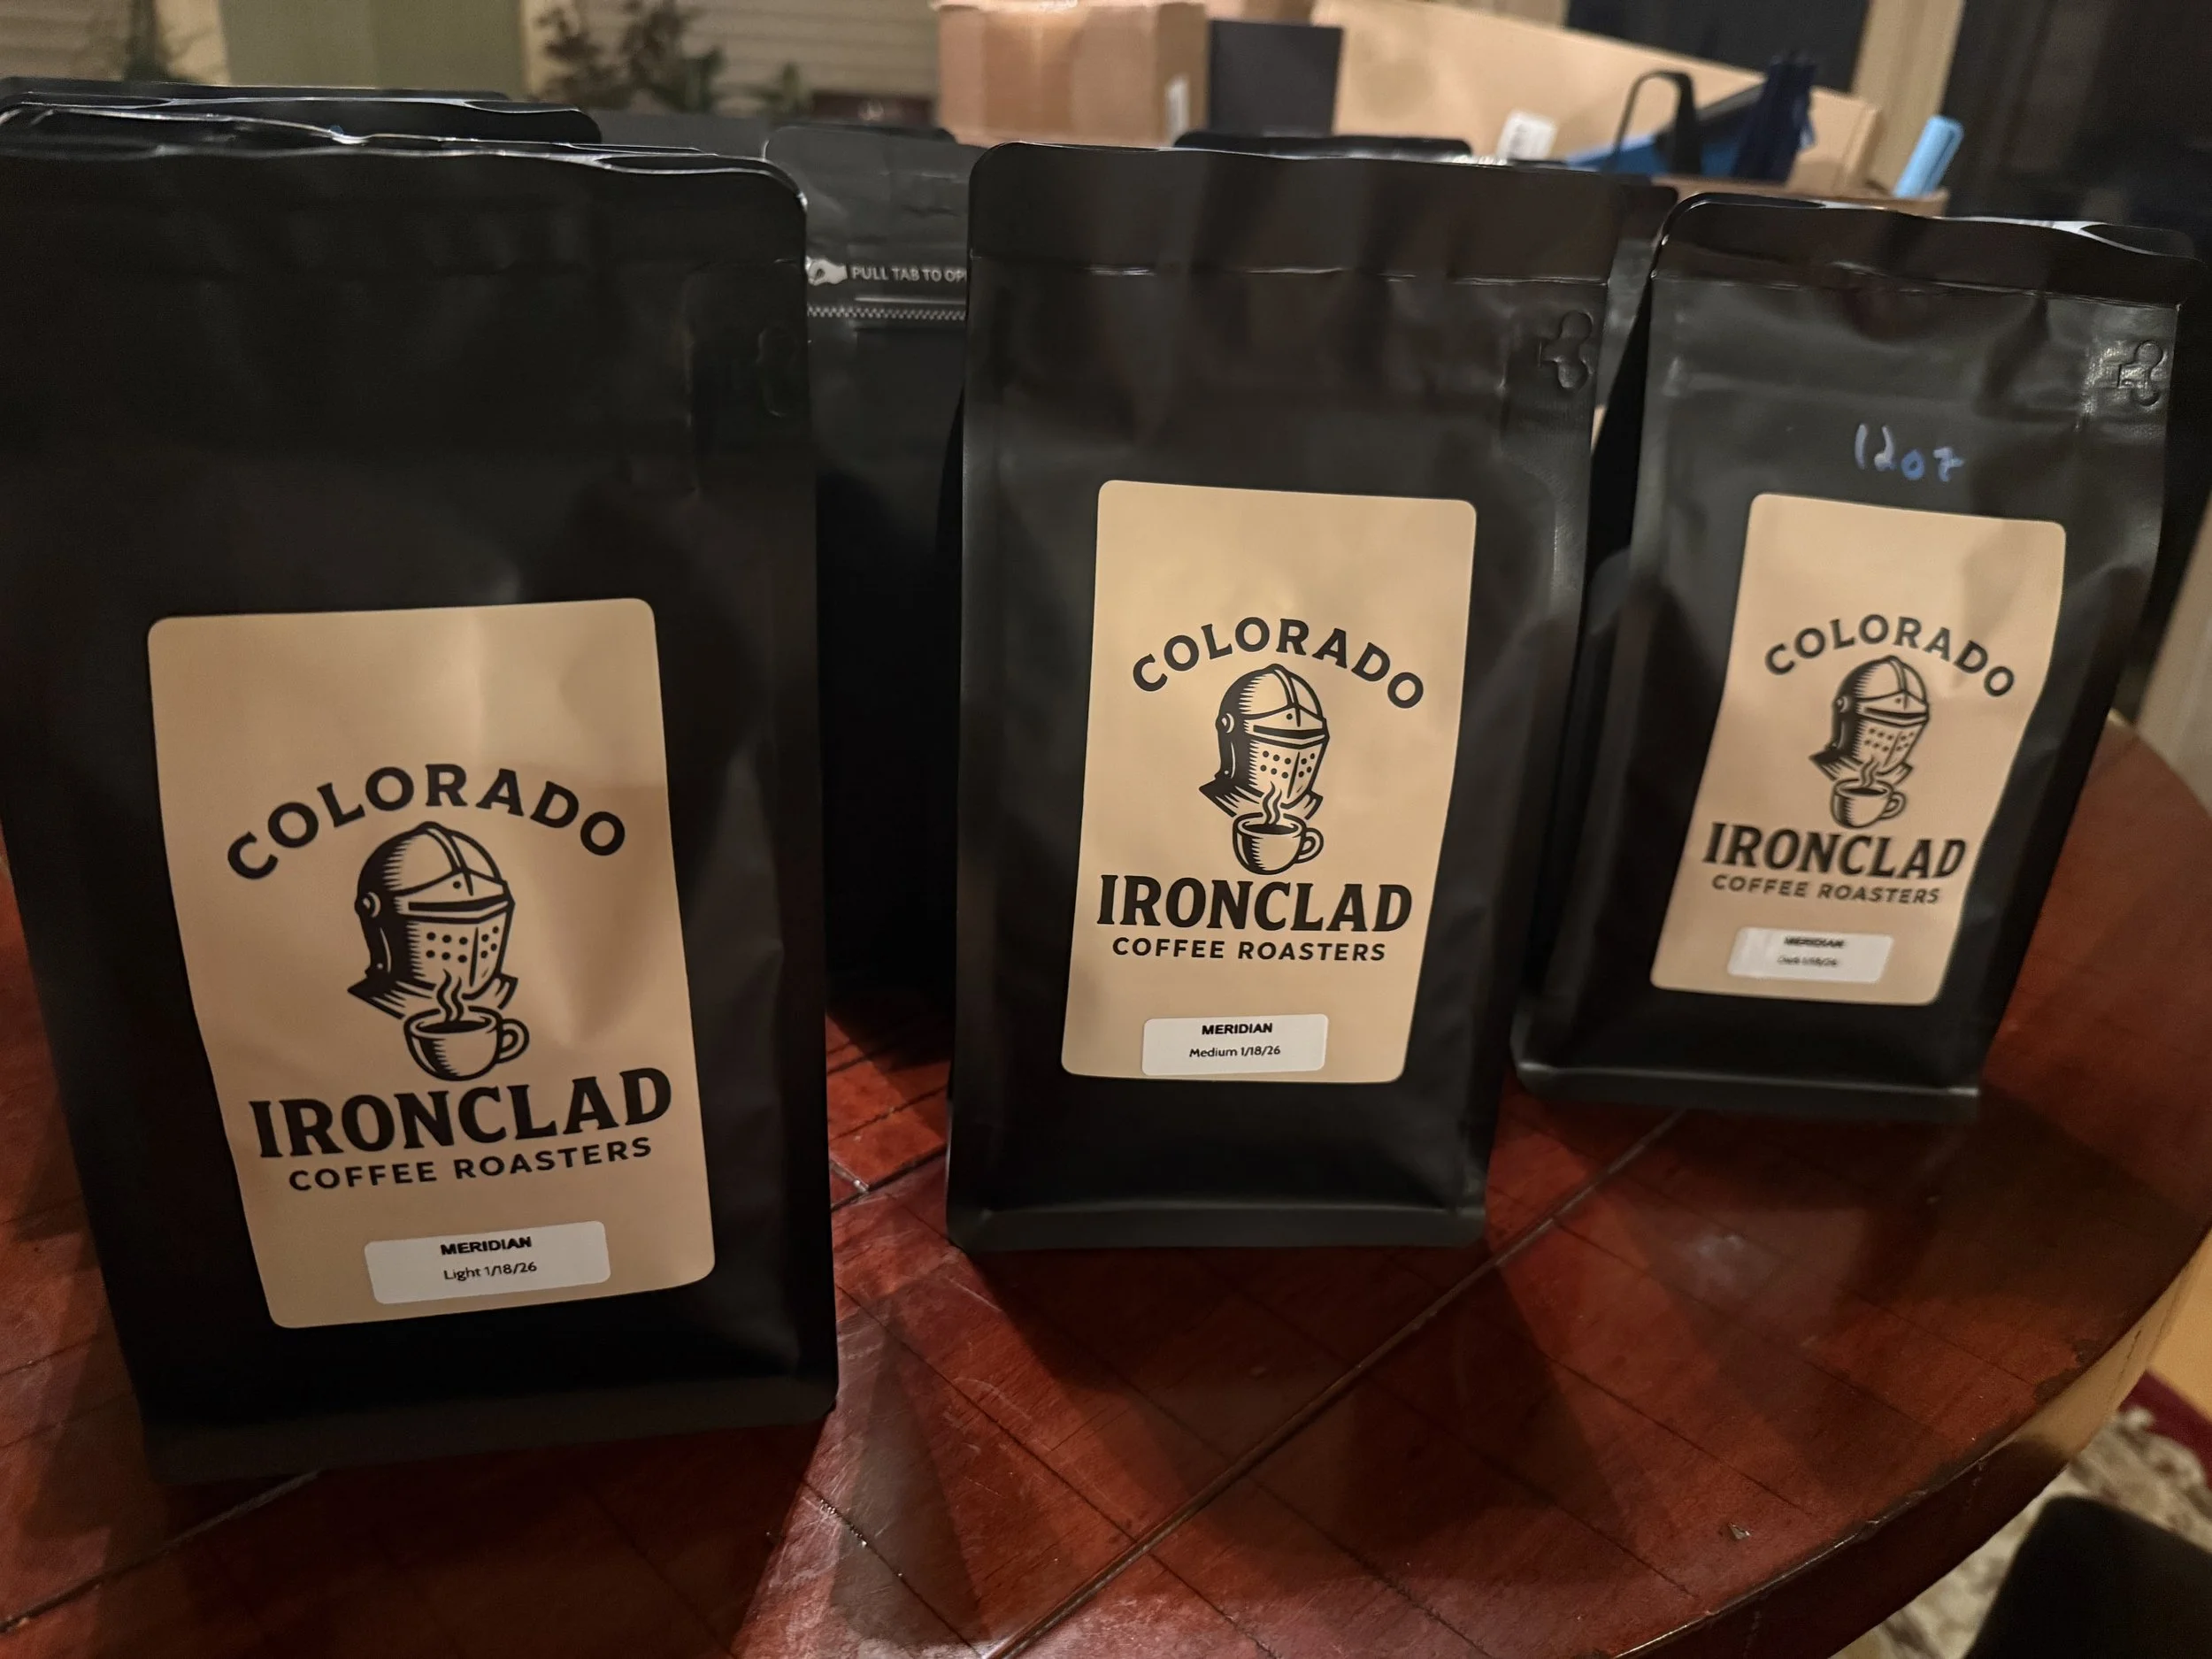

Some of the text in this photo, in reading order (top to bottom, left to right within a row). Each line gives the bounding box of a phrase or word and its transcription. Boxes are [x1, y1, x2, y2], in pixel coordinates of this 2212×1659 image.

[851, 266, 967, 282] PULL TAB TO OP
[1133, 617, 1424, 709] COLORADO
[1765, 614, 2014, 697] COLORADO
[227, 764, 626, 879] COLORADO
[1702, 822, 1966, 879] IRONCLAD
[1097, 874, 1412, 932] IRONCLAD
[1712, 873, 1940, 905] COFFEE ROASTERS
[1112, 937, 1386, 961] COFFEE ROASTERS
[1202, 1023, 1272, 1034] MERIDIAN
[1189, 1046, 1281, 1057] Medium 1/18/26
[249, 1067, 672, 1158] IRONCLAD
[288, 1137, 652, 1191] COFFEE ROASTERS
[441, 1237, 532, 1255] MERIDIAN
[443, 1262, 537, 1282] Light 1/18/26
